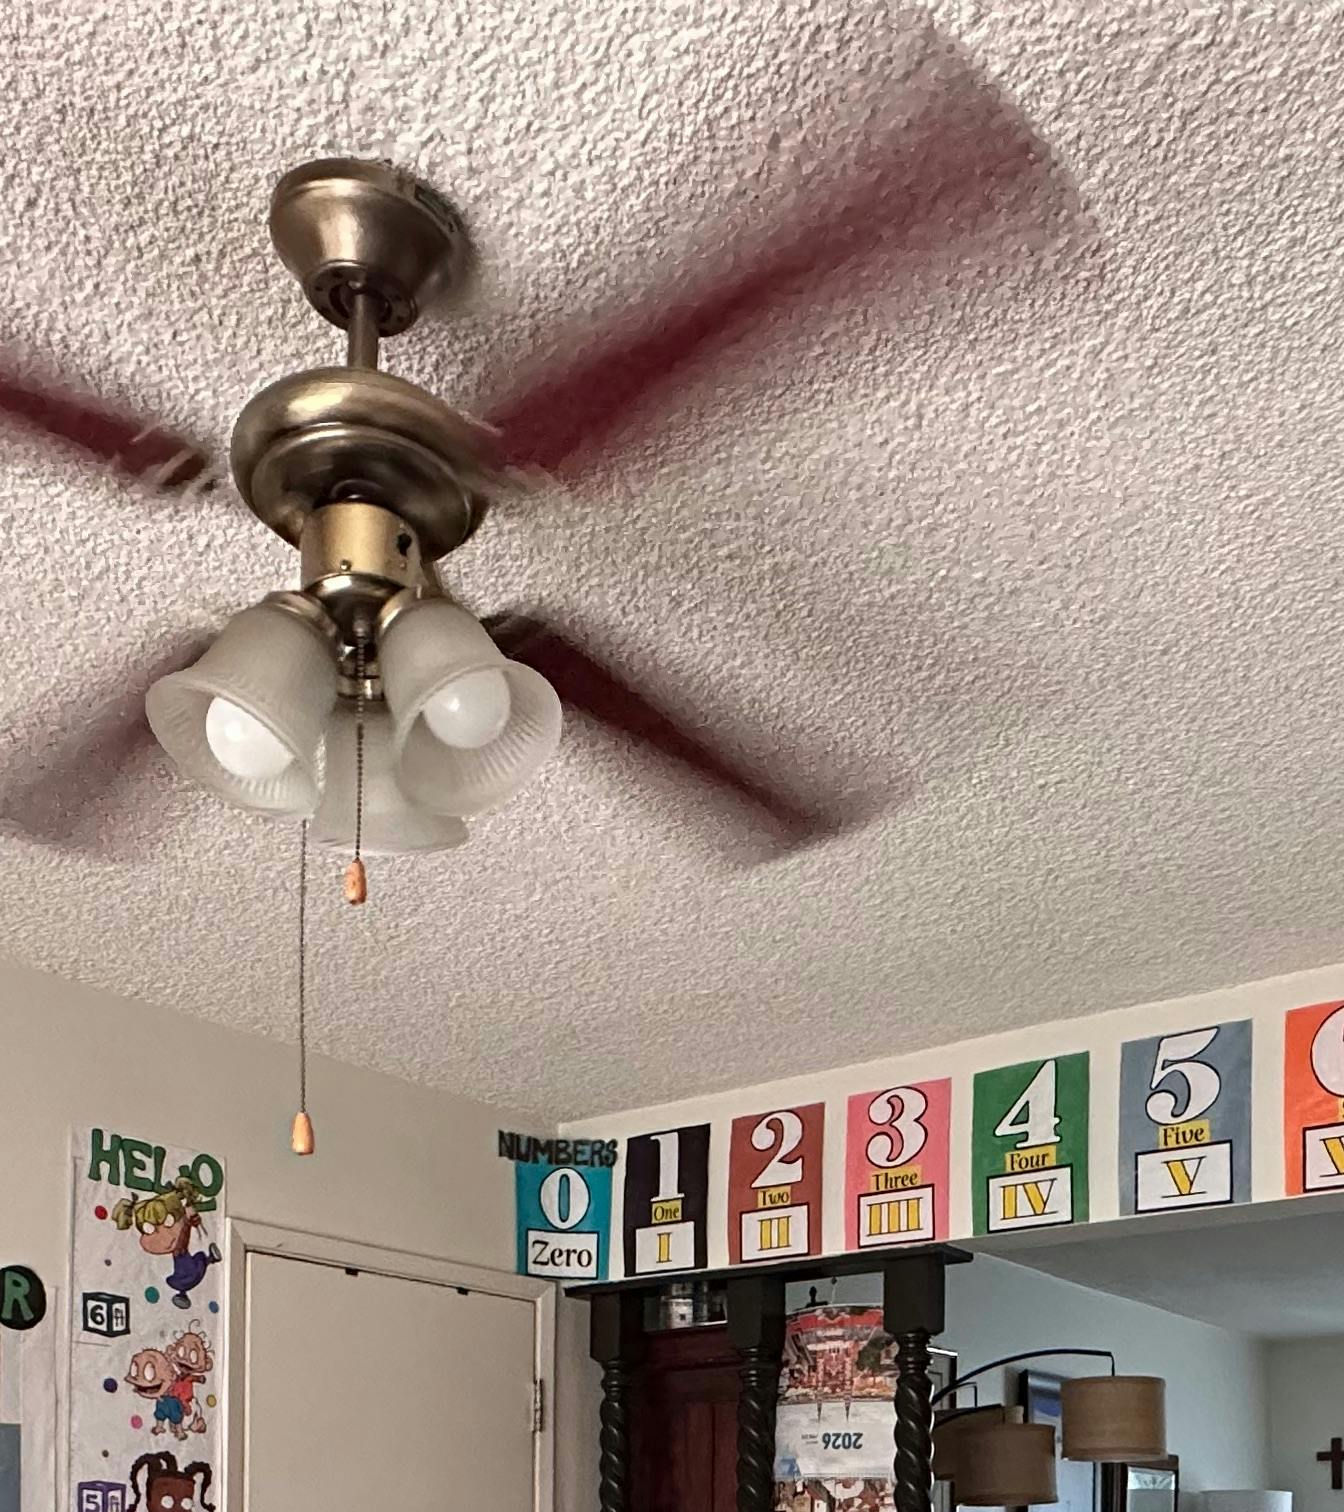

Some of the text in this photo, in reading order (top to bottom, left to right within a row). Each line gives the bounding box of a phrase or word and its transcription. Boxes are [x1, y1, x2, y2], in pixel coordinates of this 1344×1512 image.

[1146, 1026, 1221, 1125] 5
[994, 1059, 1062, 1149] 4
[866, 1086, 928, 1168] 3
[1162, 1126, 1205, 1147] Five
[498, 1130, 618, 1167] NUMBERS
[751, 1109, 803, 1189] 2
[1009, 1151, 1050, 1171] Four
[650, 1132, 685, 1202] 1
[872, 1171, 918, 1191] Three
[1161, 1156, 1206, 1198] V
[540, 1167, 590, 1231] 0
[654, 1204, 681, 1221] One
[759, 1190, 790, 1206] Two
[999, 1176, 1058, 1219] IV
[758, 1216, 791, 1250] II
[867, 1197, 923, 1235] III
[532, 1240, 593, 1268] Zero
[656, 1231, 672, 1263] I
[89, 1304, 105, 1326] 6
[822, 1432, 863, 1450] 2026
